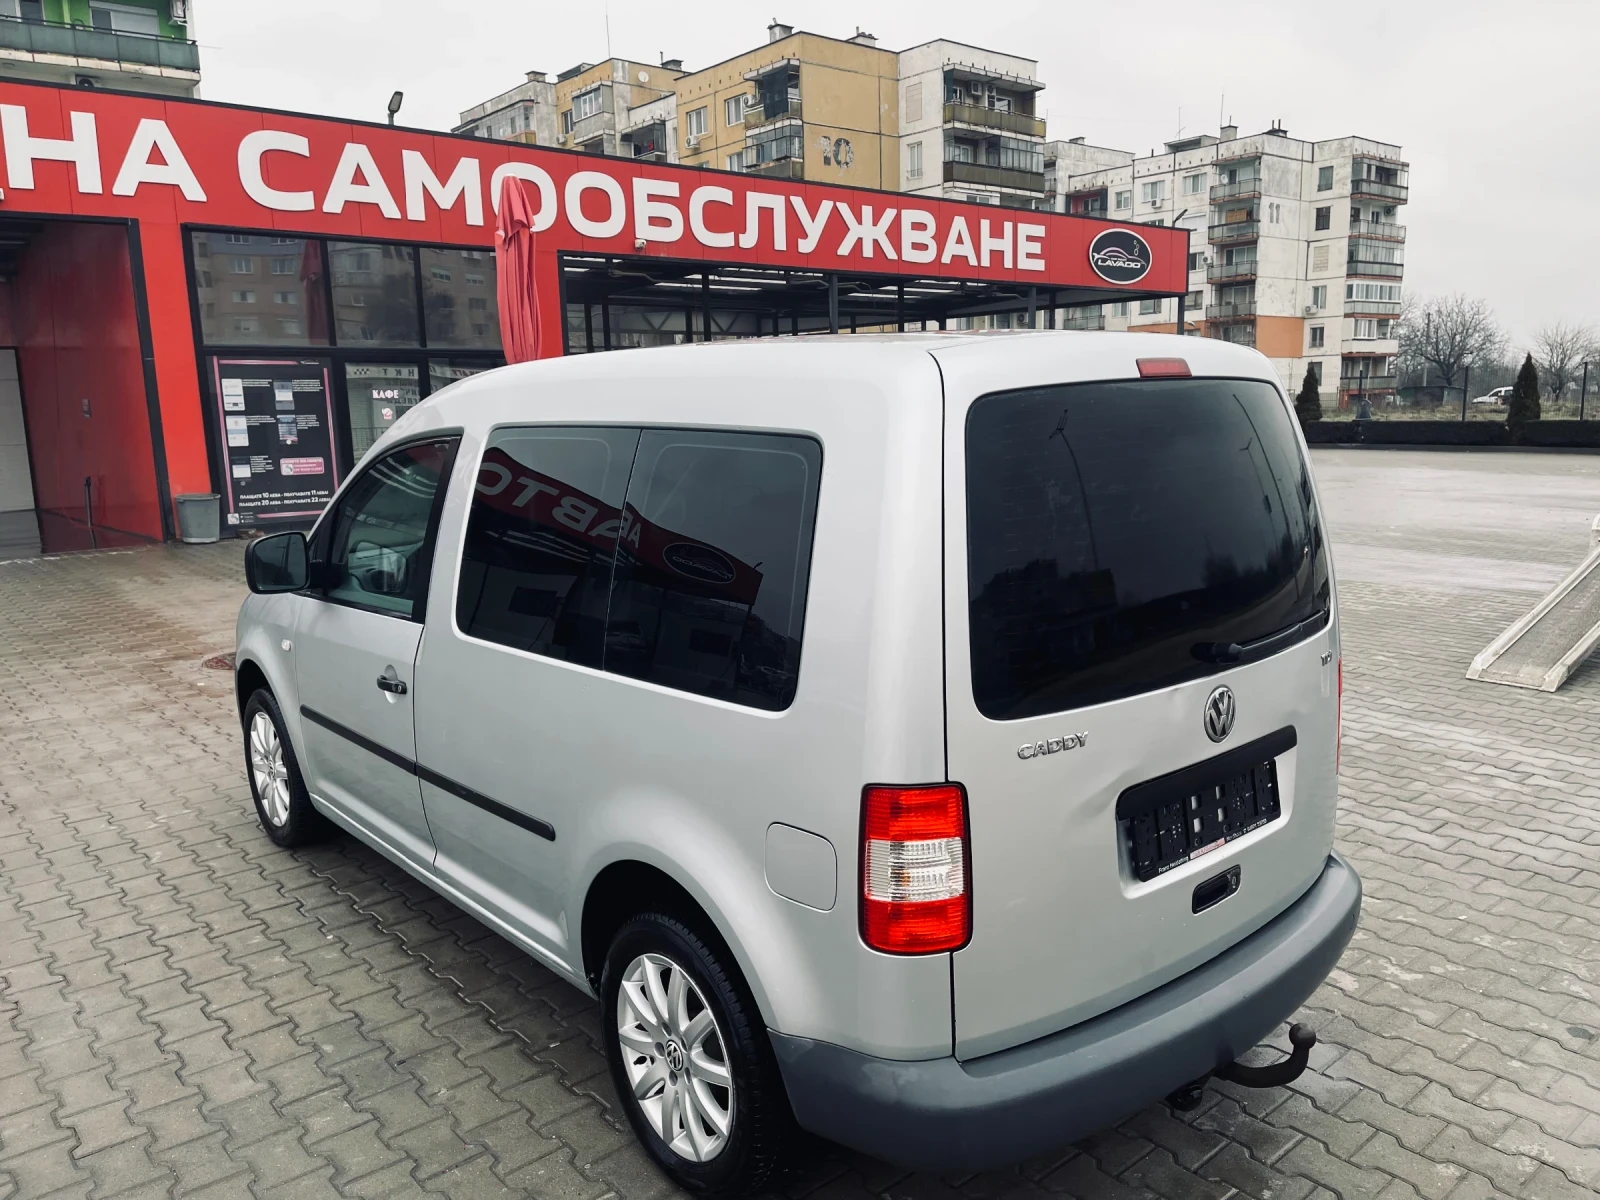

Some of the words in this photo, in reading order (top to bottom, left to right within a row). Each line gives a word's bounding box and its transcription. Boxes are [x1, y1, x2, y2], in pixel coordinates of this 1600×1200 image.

[818, 136, 854, 168] 10
[0, 103, 207, 202] НА
[237, 129, 1046, 271] САМООБСЛУЖВАНЕ
[1269, 203, 1281, 224] 11
[1098, 259, 1141, 268] LAVADO
[372, 389, 399, 399] КАФЕ
[1017, 731, 1089, 759] CADDY
